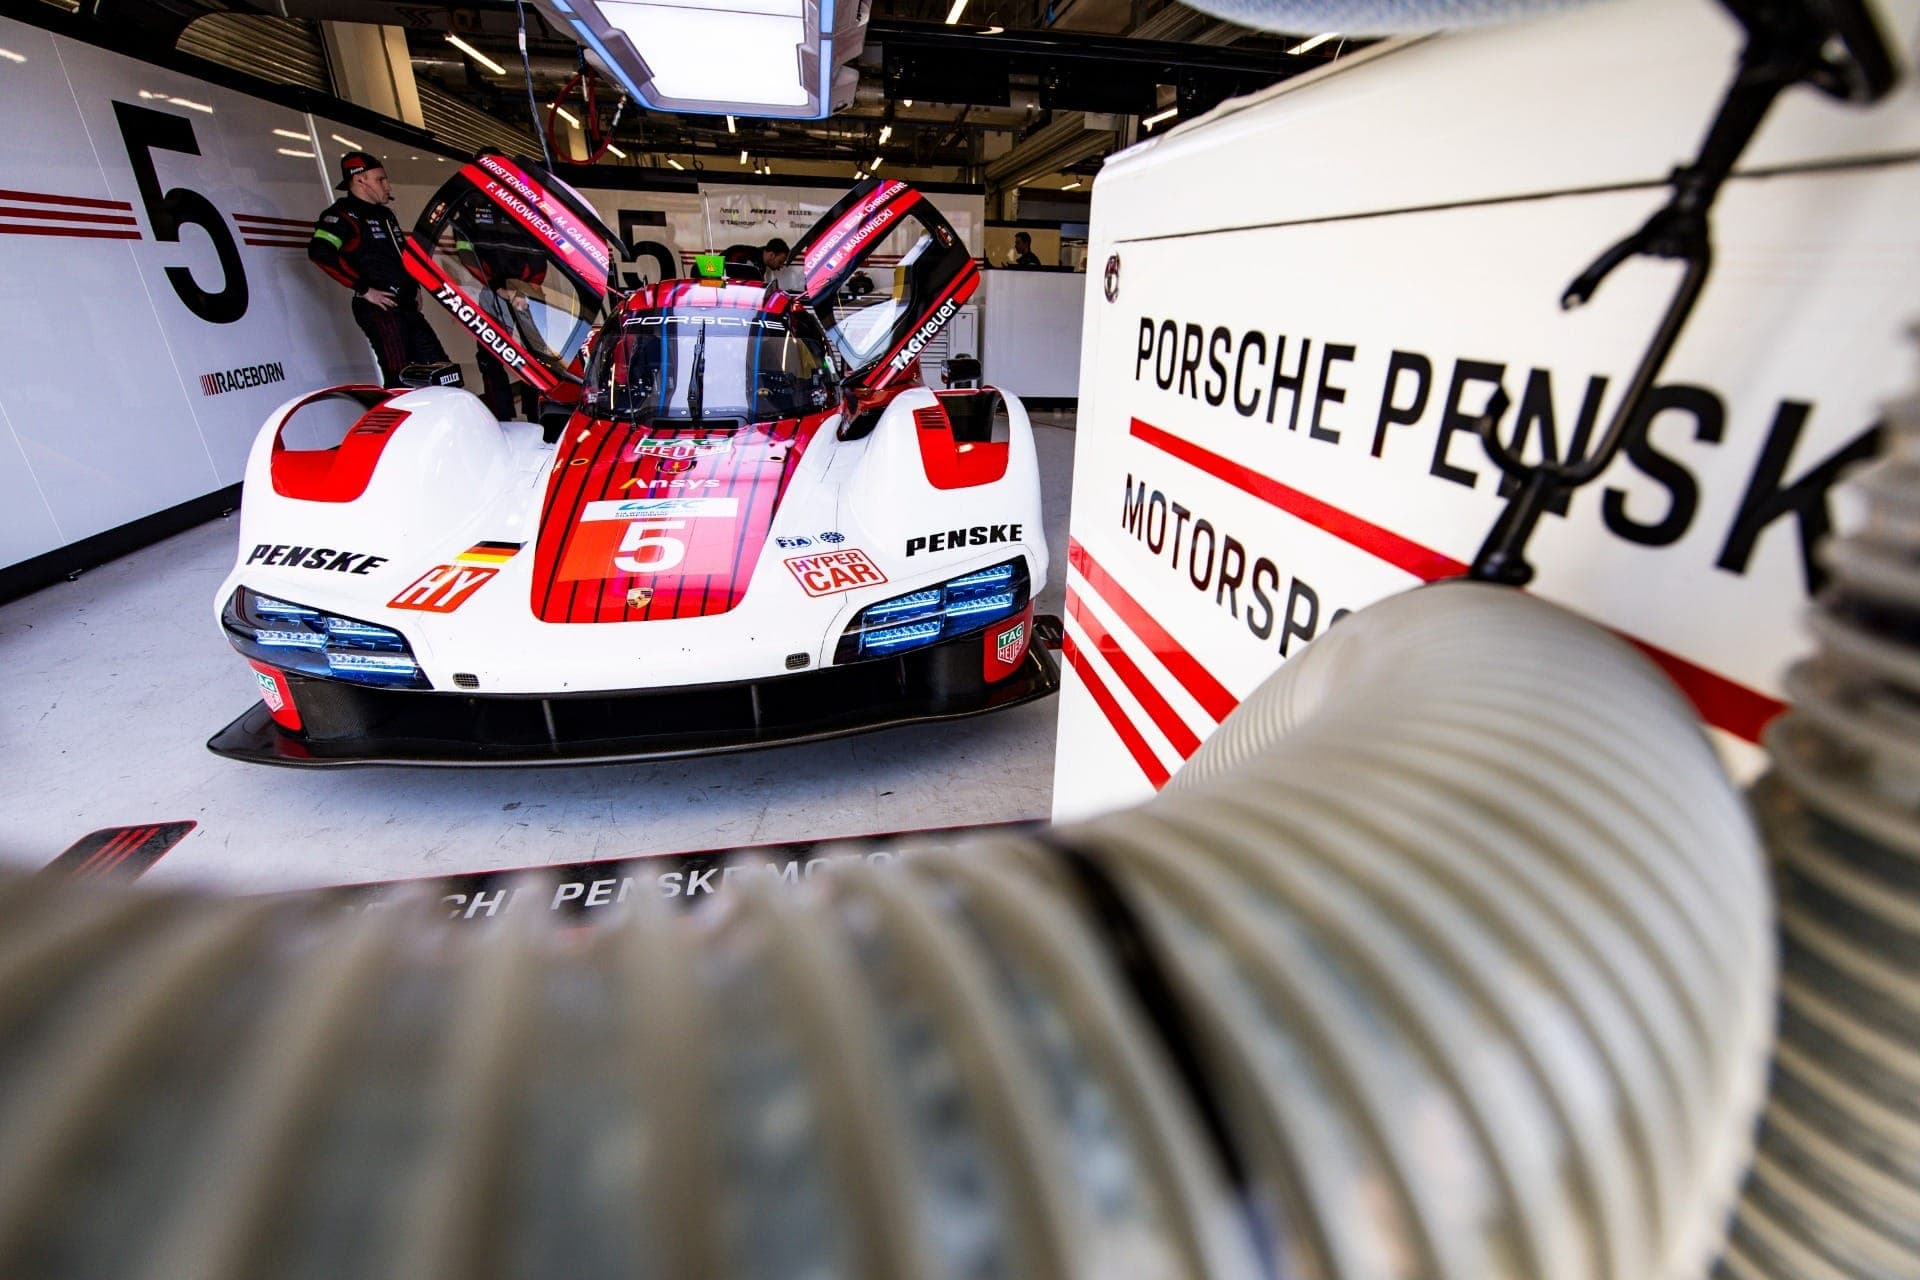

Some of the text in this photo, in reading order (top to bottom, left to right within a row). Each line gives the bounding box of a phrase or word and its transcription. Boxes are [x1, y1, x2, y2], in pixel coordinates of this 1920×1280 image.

[111, 100, 248, 324] 5
[479, 157, 540, 202] HRISTENSEN
[567, 227, 609, 267] CAMPBEL
[486, 182, 497, 192] F.
[495, 188, 559, 240] MAKOWIECKI
[843, 208, 894, 251] MAKOWIECKI
[618, 209, 676, 288] 5
[622, 316, 785, 331] PORSCHE
[215, 361, 285, 393] RACEBORN
[1136, 316, 1887, 596] PORSCHE PENSK
[619, 478, 720, 490] Ansys
[614, 521, 686, 573] 5
[905, 524, 1022, 557] PENSKE
[245, 544, 389, 575] PENSKE
[792, 552, 863, 572] HYPER
[804, 564, 879, 591] CAR
[394, 567, 493, 607] HY
[1000, 626, 1022, 645] TAG
